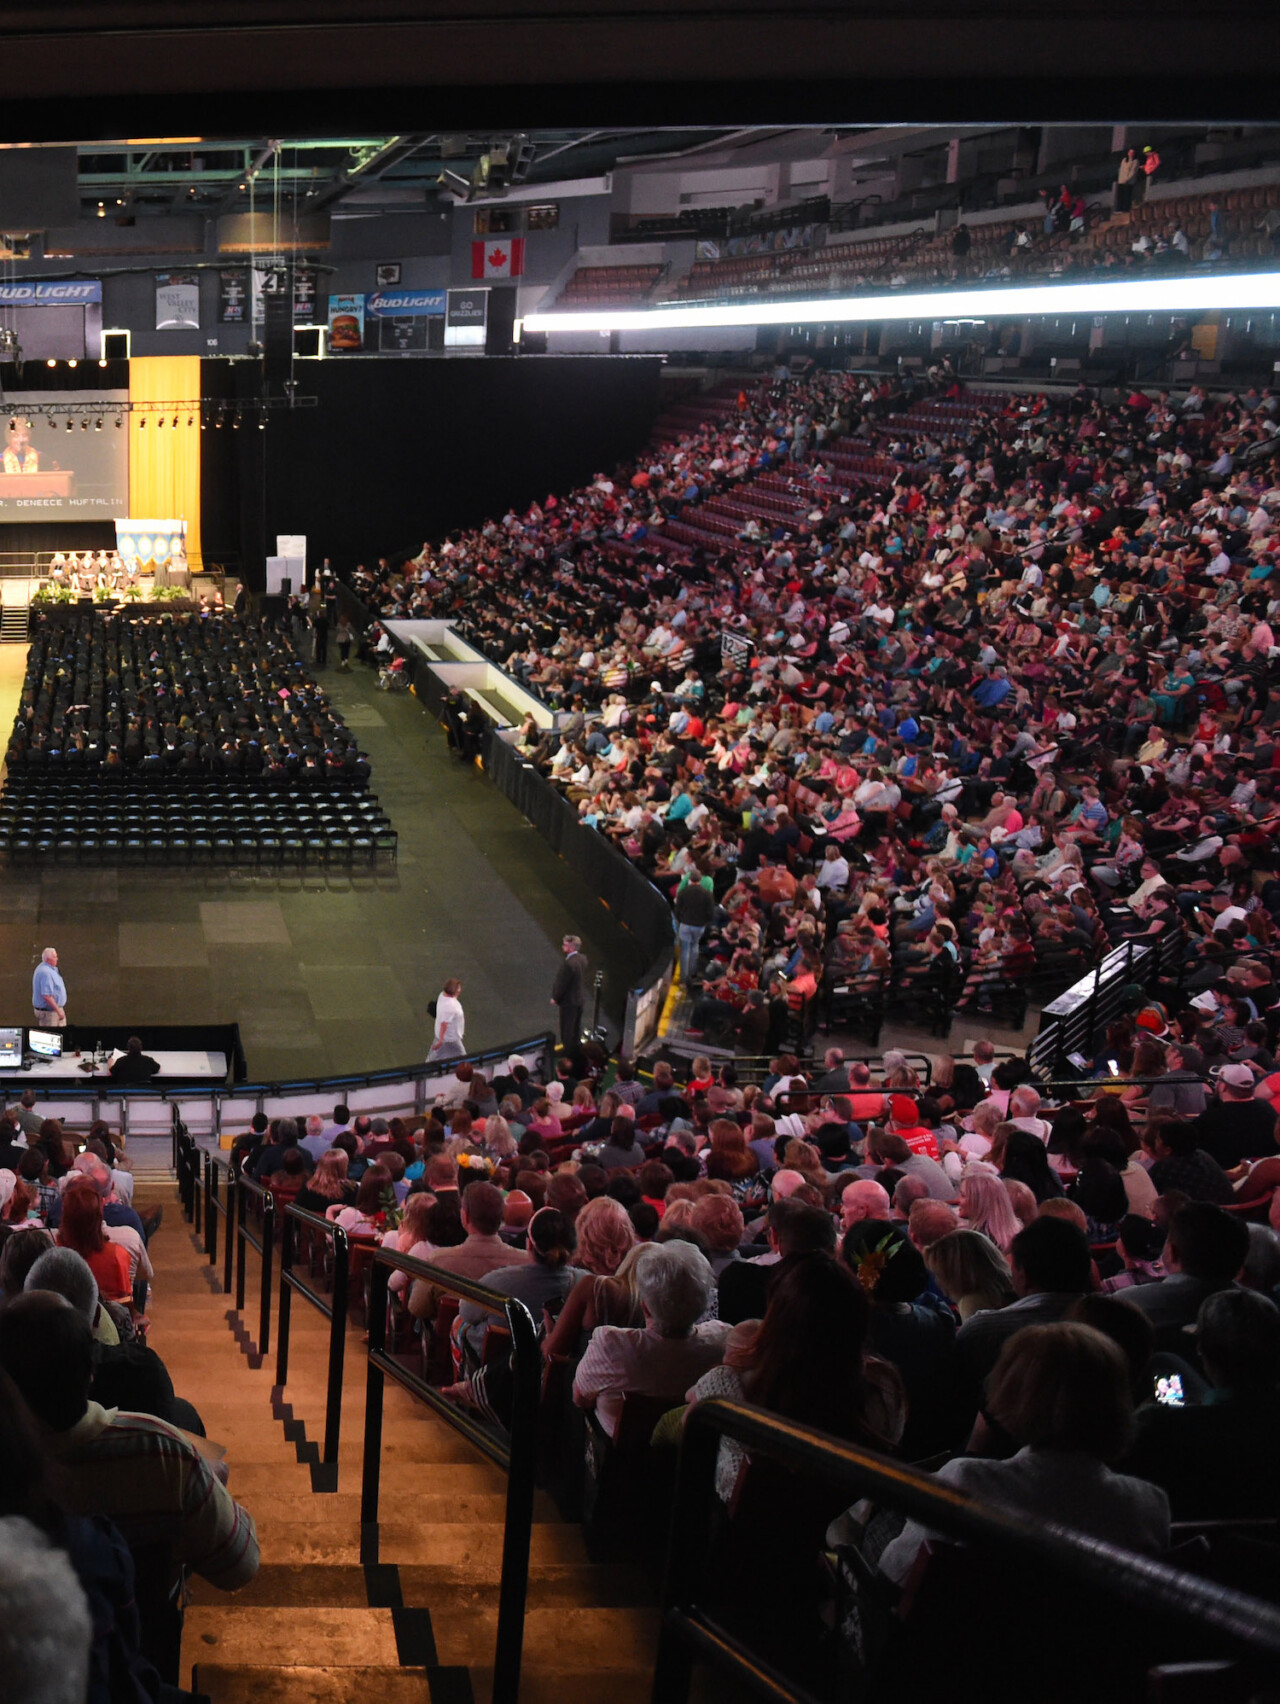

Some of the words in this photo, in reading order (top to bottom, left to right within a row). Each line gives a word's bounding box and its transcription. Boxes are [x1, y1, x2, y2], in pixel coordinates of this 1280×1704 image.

[33, 285, 95, 298] LIGHT
[373, 298, 402, 309] BUD
[402, 296, 444, 307] LIGHT
[16, 499, 62, 507] DENEECE
